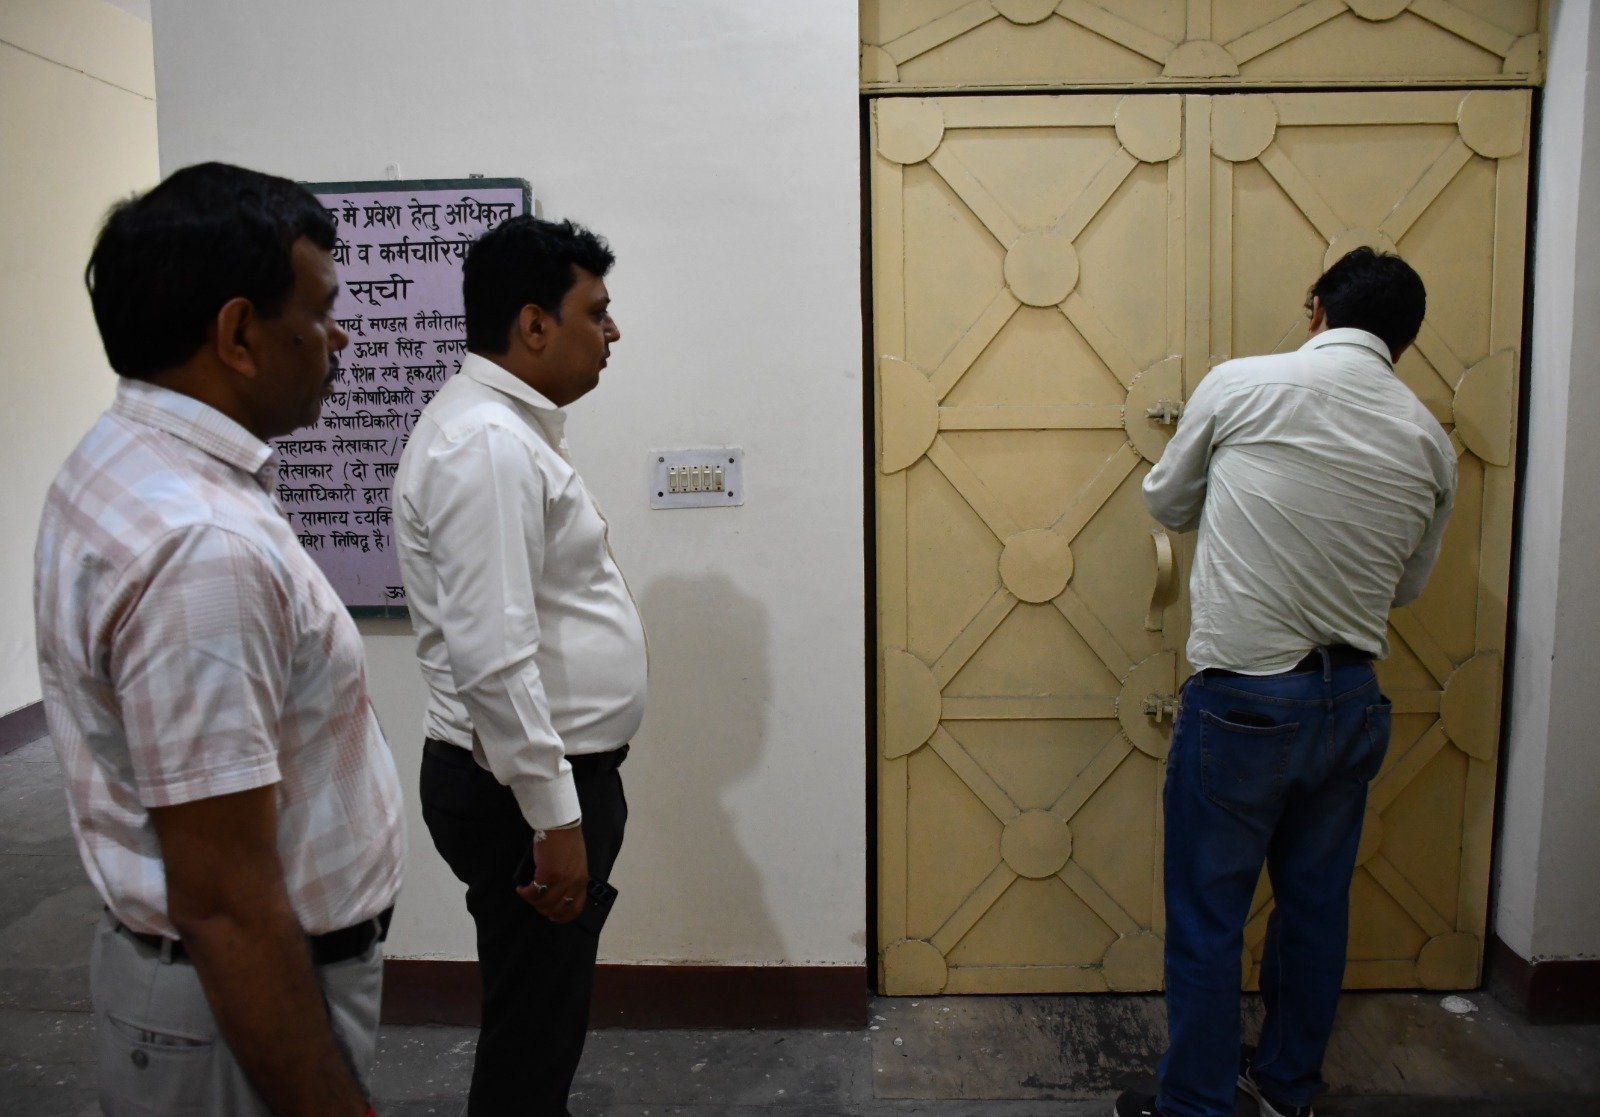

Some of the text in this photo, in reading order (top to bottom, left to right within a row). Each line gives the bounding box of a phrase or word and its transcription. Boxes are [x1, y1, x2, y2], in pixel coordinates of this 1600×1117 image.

[342, 200, 360, 228] में
[363, 201, 402, 230] प्रवेश
[407, 198, 442, 231] हेतु
[357, 244, 373, 265] व
[346, 273, 414, 306] सूची
[368, 316, 407, 333] मण्डल
[354, 341, 389, 359] ऊधम
[395, 337, 427, 360] सिंह
[350, 362, 377, 383] पेंशन
[403, 360, 447, 385] हकदारी
[322, 408, 403, 430] कोषाधिकारी
[275, 440, 327, 458] सहायक
[276, 483, 390, 504] जिलाधिकारी द्वारा
[298, 511, 349, 527] सामान्य
